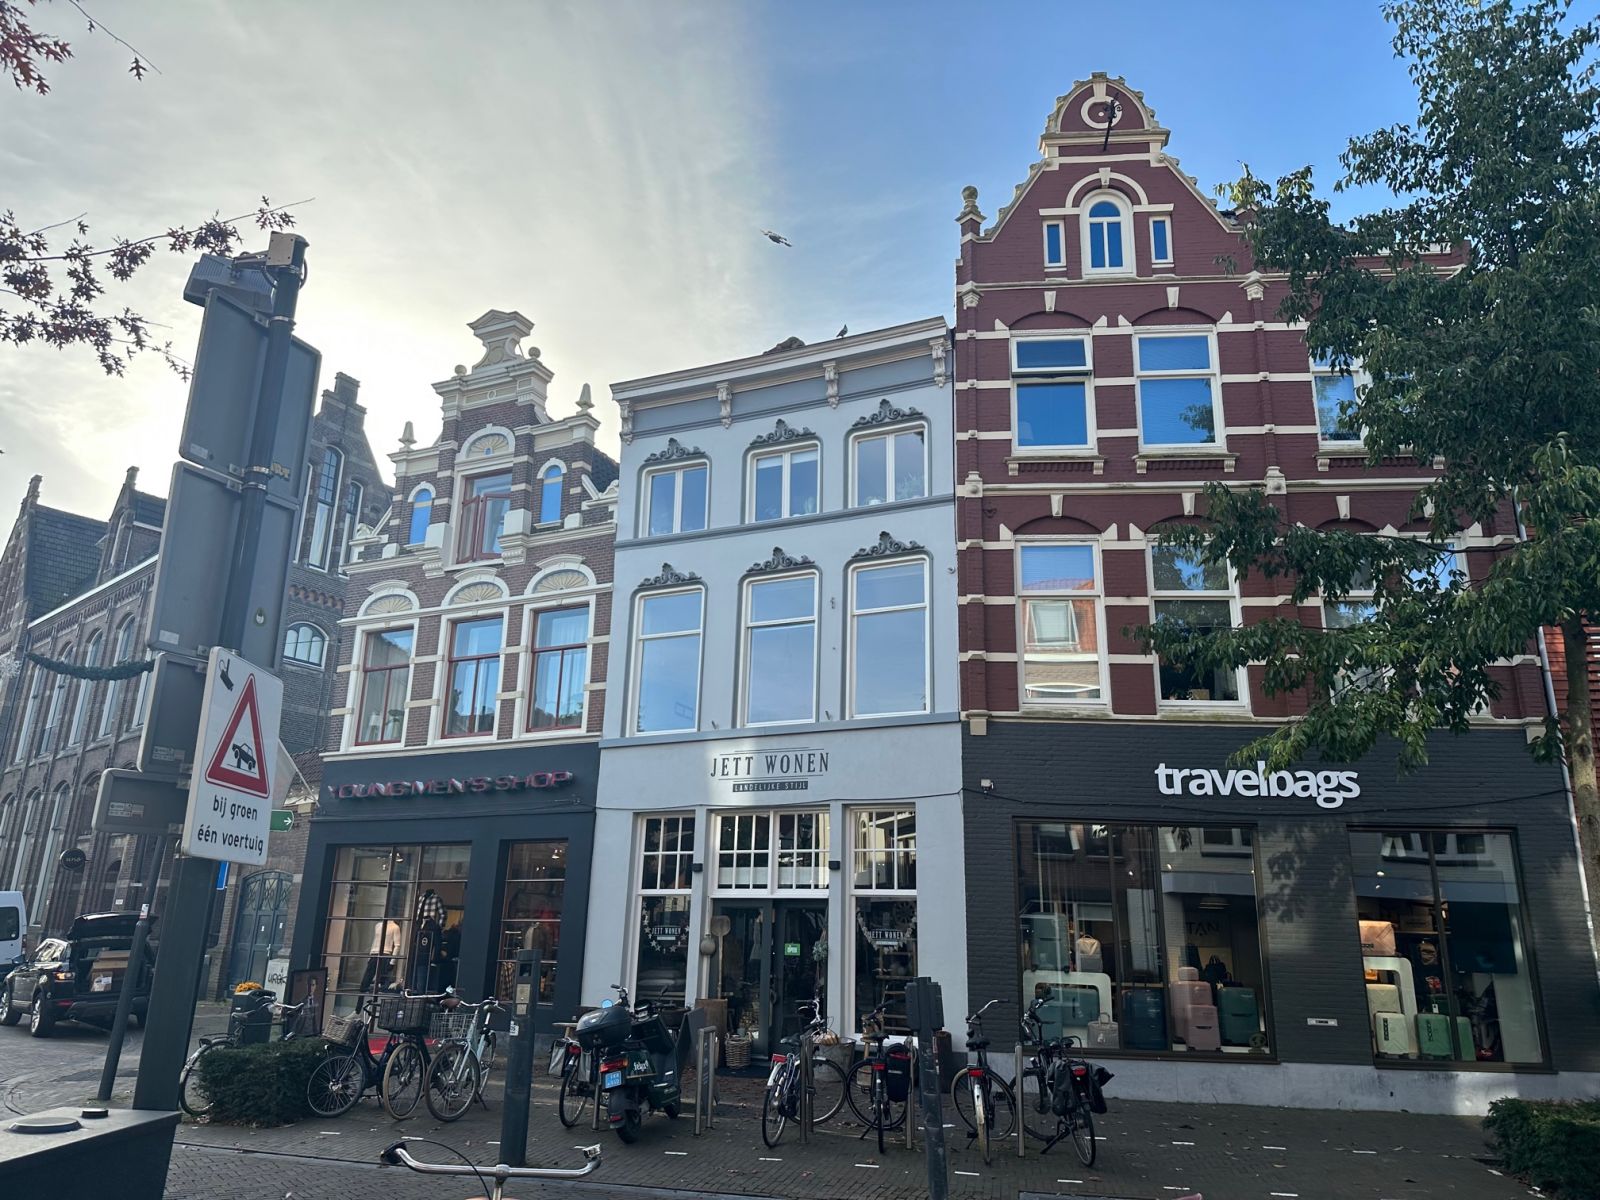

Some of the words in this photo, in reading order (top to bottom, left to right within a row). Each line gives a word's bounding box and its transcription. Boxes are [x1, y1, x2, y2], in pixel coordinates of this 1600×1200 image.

[710, 756, 753, 777] JETT
[765, 752, 829, 774] WONEN
[327, 781, 411, 799] YOUNG
[495, 771, 573, 791] SHOP
[734, 782, 780, 792] LANDELIJKE
[784, 781, 807, 790] STIJL
[1154, 760, 1361, 809] travelbags
[213, 794, 228, 819] bij
[230, 802, 258, 821] groen
[197, 823, 218, 844] één
[222, 832, 264, 857] voertuig
